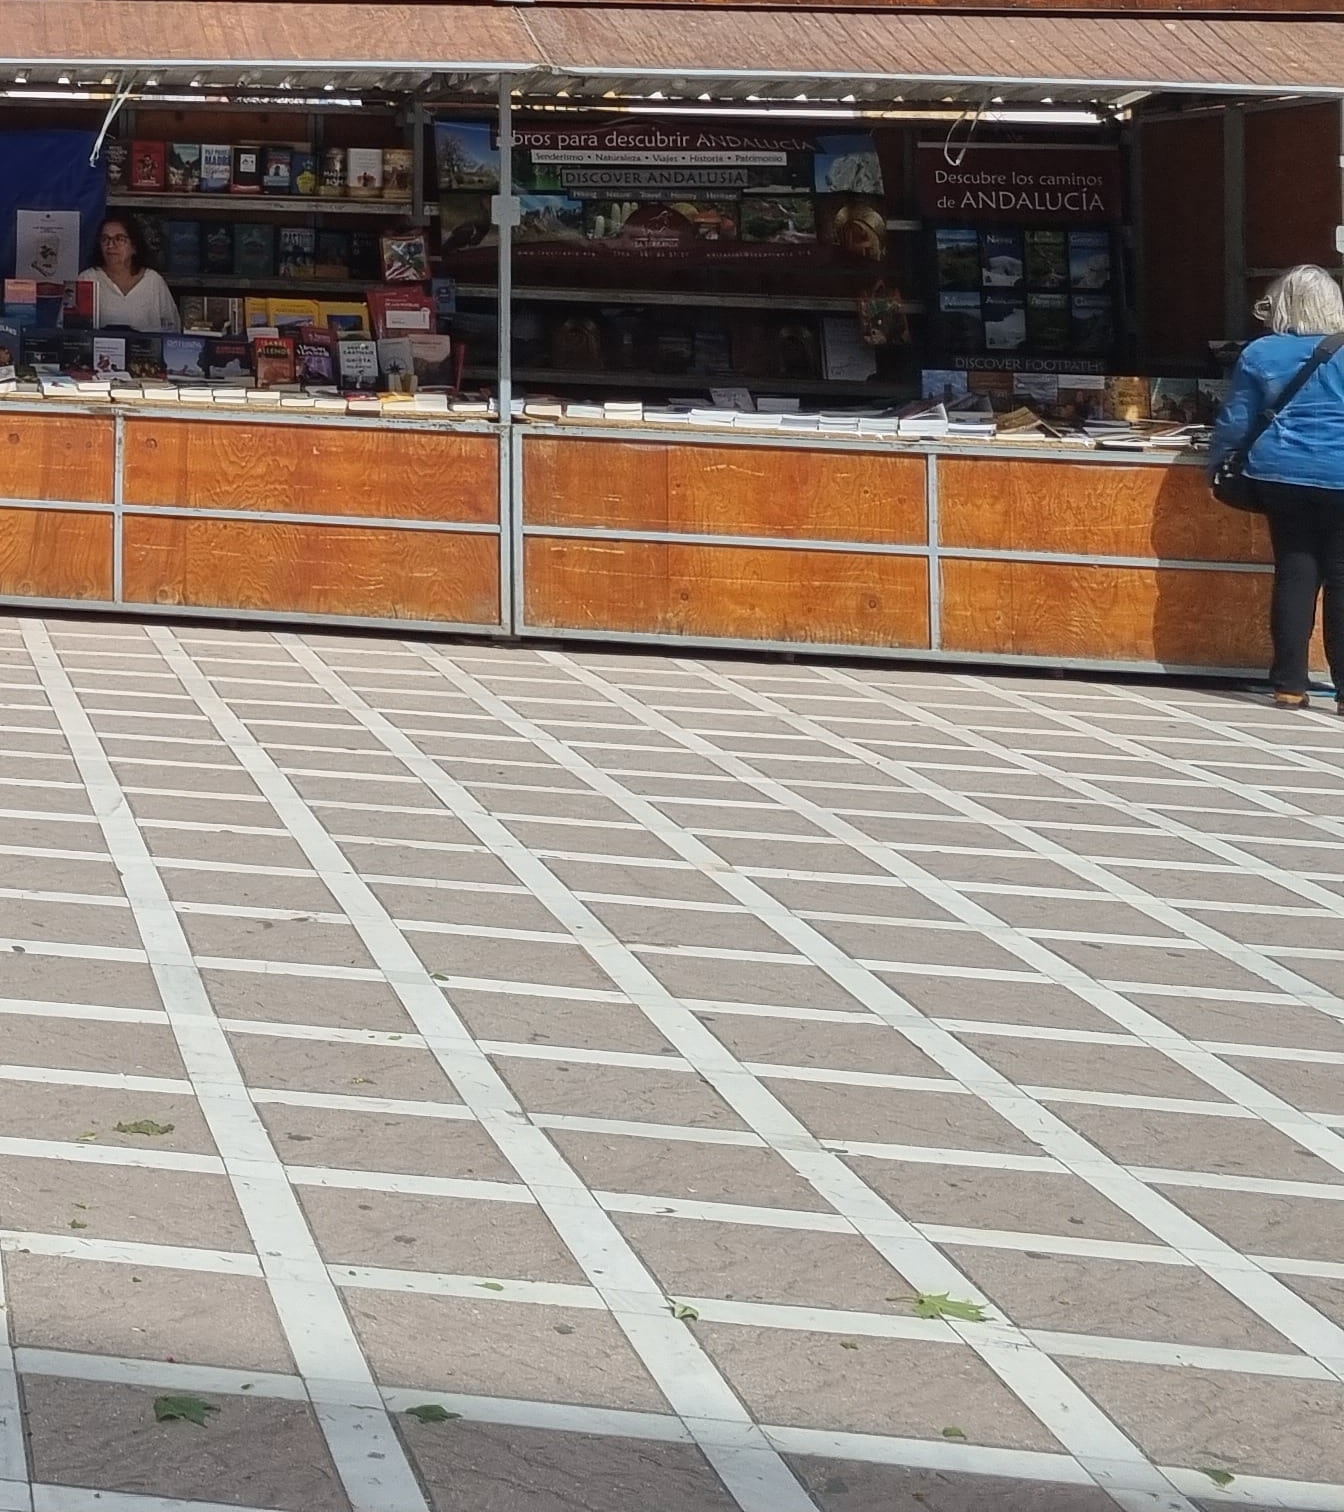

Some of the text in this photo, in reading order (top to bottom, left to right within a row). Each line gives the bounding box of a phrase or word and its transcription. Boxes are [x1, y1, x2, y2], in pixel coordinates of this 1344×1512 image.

[557, 134, 598, 150] para
[604, 131, 690, 147] descubrir
[535, 152, 783, 163] Senderismo Naturaleza Viajes Historia Patrimonio
[565, 172, 745, 184] DISCOVER ANDALUSIA
[935, 170, 1104, 187] Descubre los caminos
[936, 187, 1105, 212] de ANDALUCÍA
[257, 346, 290, 355] ALLENDE
[954, 356, 1021, 370] DISCOVER
